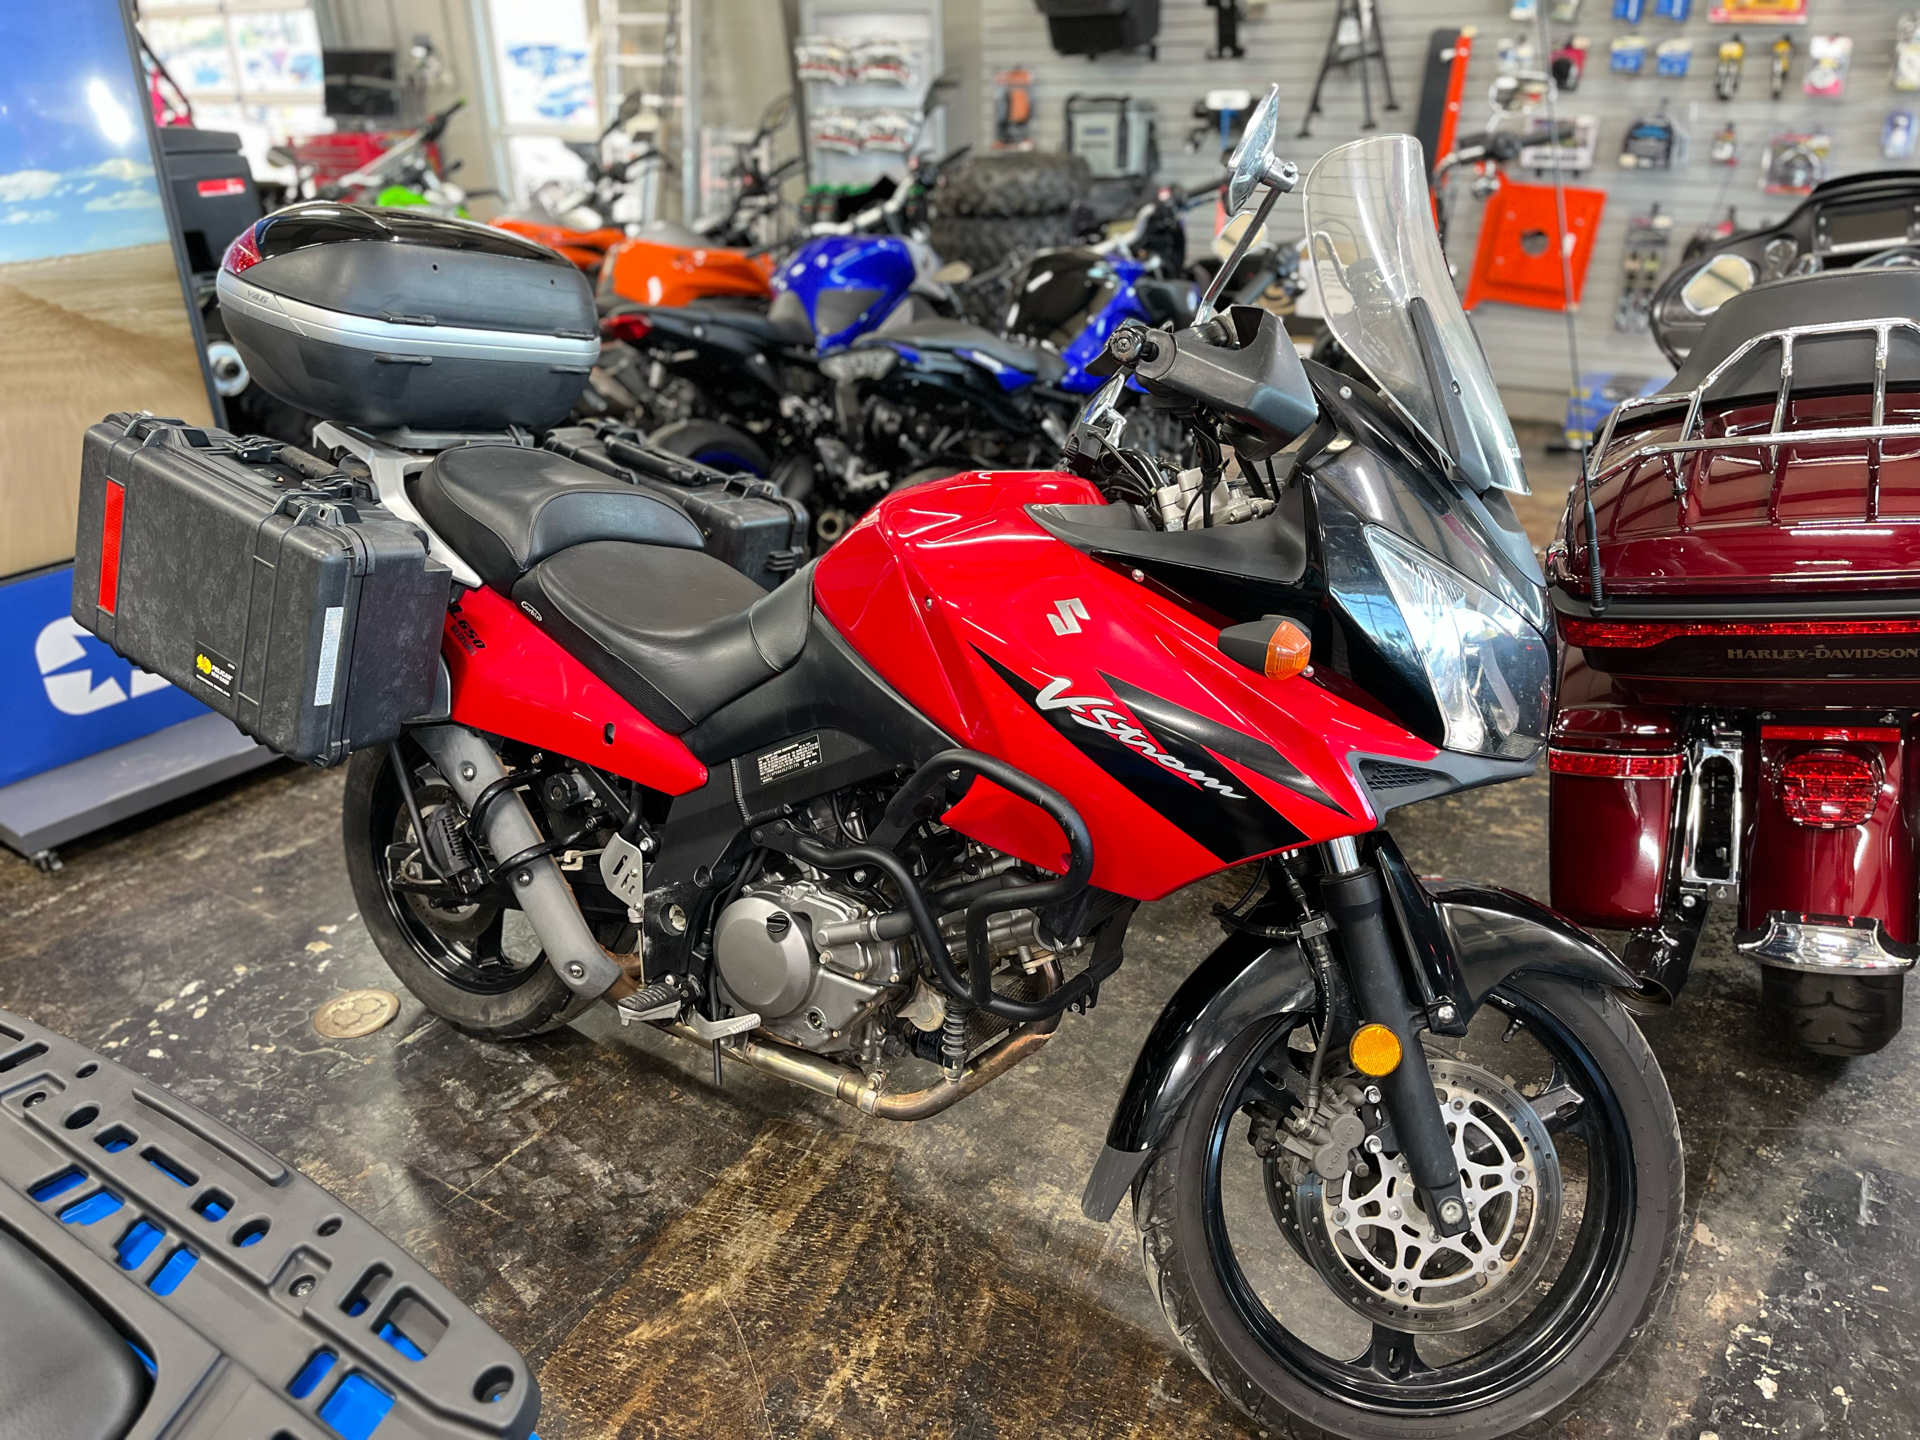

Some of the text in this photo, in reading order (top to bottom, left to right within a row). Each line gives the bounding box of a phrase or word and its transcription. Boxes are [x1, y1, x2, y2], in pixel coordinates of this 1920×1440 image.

[247, 290, 269, 304] V46
[450, 624, 477, 656] SUZUKI
[1727, 648, 1918, 660] HARLEY-DAVIDSON
[211, 664, 233, 681] PELICAN
